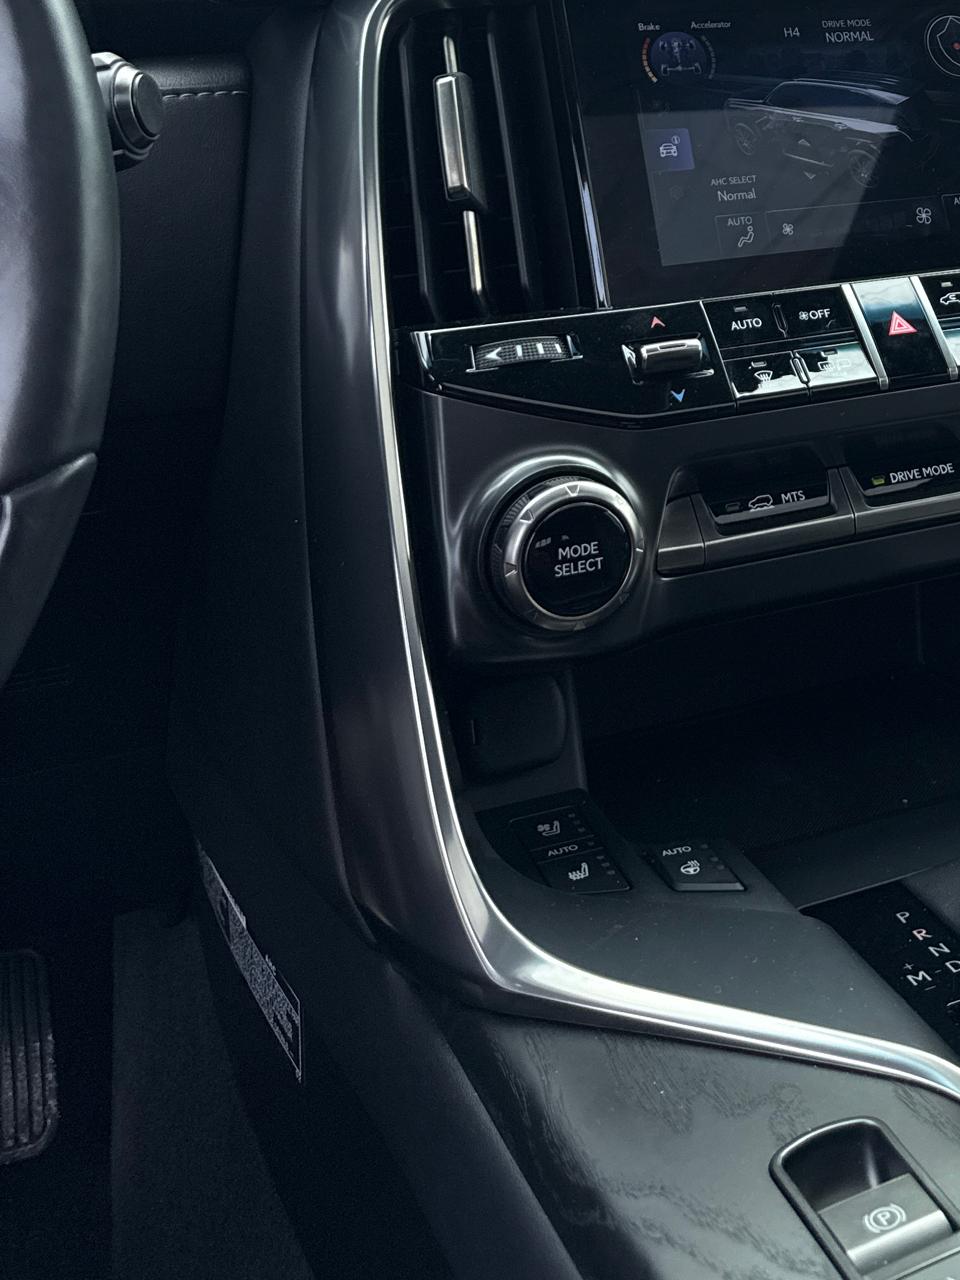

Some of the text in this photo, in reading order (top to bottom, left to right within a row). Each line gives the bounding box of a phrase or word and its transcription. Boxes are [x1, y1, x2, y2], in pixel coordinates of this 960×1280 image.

[638, 22, 661, 31] Brake
[691, 20, 731, 29] Accelerator
[821, 18, 872, 29] DRIVE MODE
[783, 26, 801, 38] H4
[825, 31, 875, 43] NORMAL
[728, 175, 757, 185] SELECT
[717, 187, 757, 202] Normal
[727, 215, 753, 226] AUTO
[809, 308, 831, 320] OFF
[731, 317, 763, 331] AUTO
[889, 462, 955, 484] DRIVE MODE
[780, 489, 806, 504] MTS
[557, 541, 600, 561] MODE
[554, 556, 605, 578] SELECT
[547, 844, 579, 857] AUTO
[662, 845, 692, 857] AUTO
[895, 911, 910, 924] P
[911, 928, 933, 941] R
[927, 942, 951, 957] N
[905, 970, 933, 986] M
